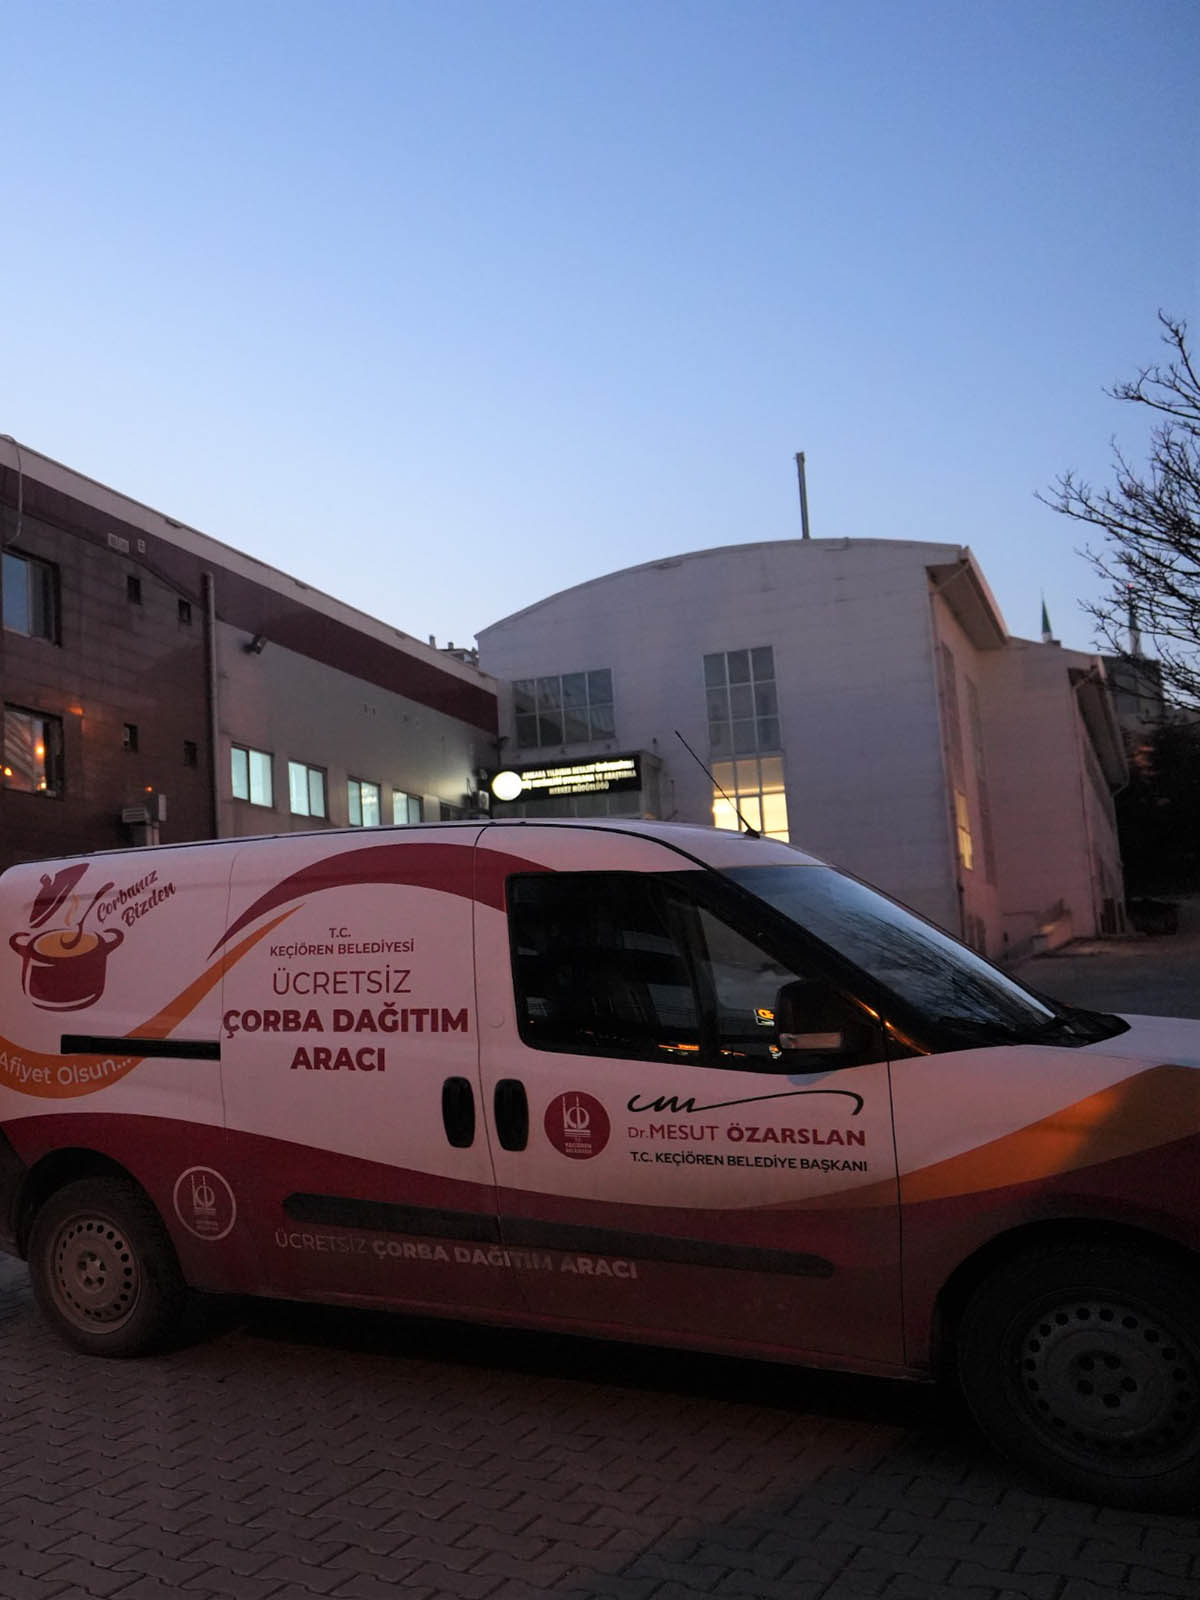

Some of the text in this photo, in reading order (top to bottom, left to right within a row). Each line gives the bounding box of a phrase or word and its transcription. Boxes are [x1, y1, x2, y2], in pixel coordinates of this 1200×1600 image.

[121, 882, 177, 927] Bizden
[329, 927, 352, 938] T.C.
[270, 938, 415, 959] KEÇİÖREN BELEDİYESİ
[273, 965, 412, 995] ÜCRETSİZ
[222, 1001, 468, 1039] ÇORBA DAĞITIM
[290, 1047, 386, 1072] ARACI
[726, 1125, 866, 1146] ÖZARSLAN
[630, 1150, 868, 1174] T.C. KEÇİÖREN BELEDİYE BAŞKANI
[275, 1228, 638, 1280] ÜCRETSİZ ÇORBA DAĞITIM ARACI
